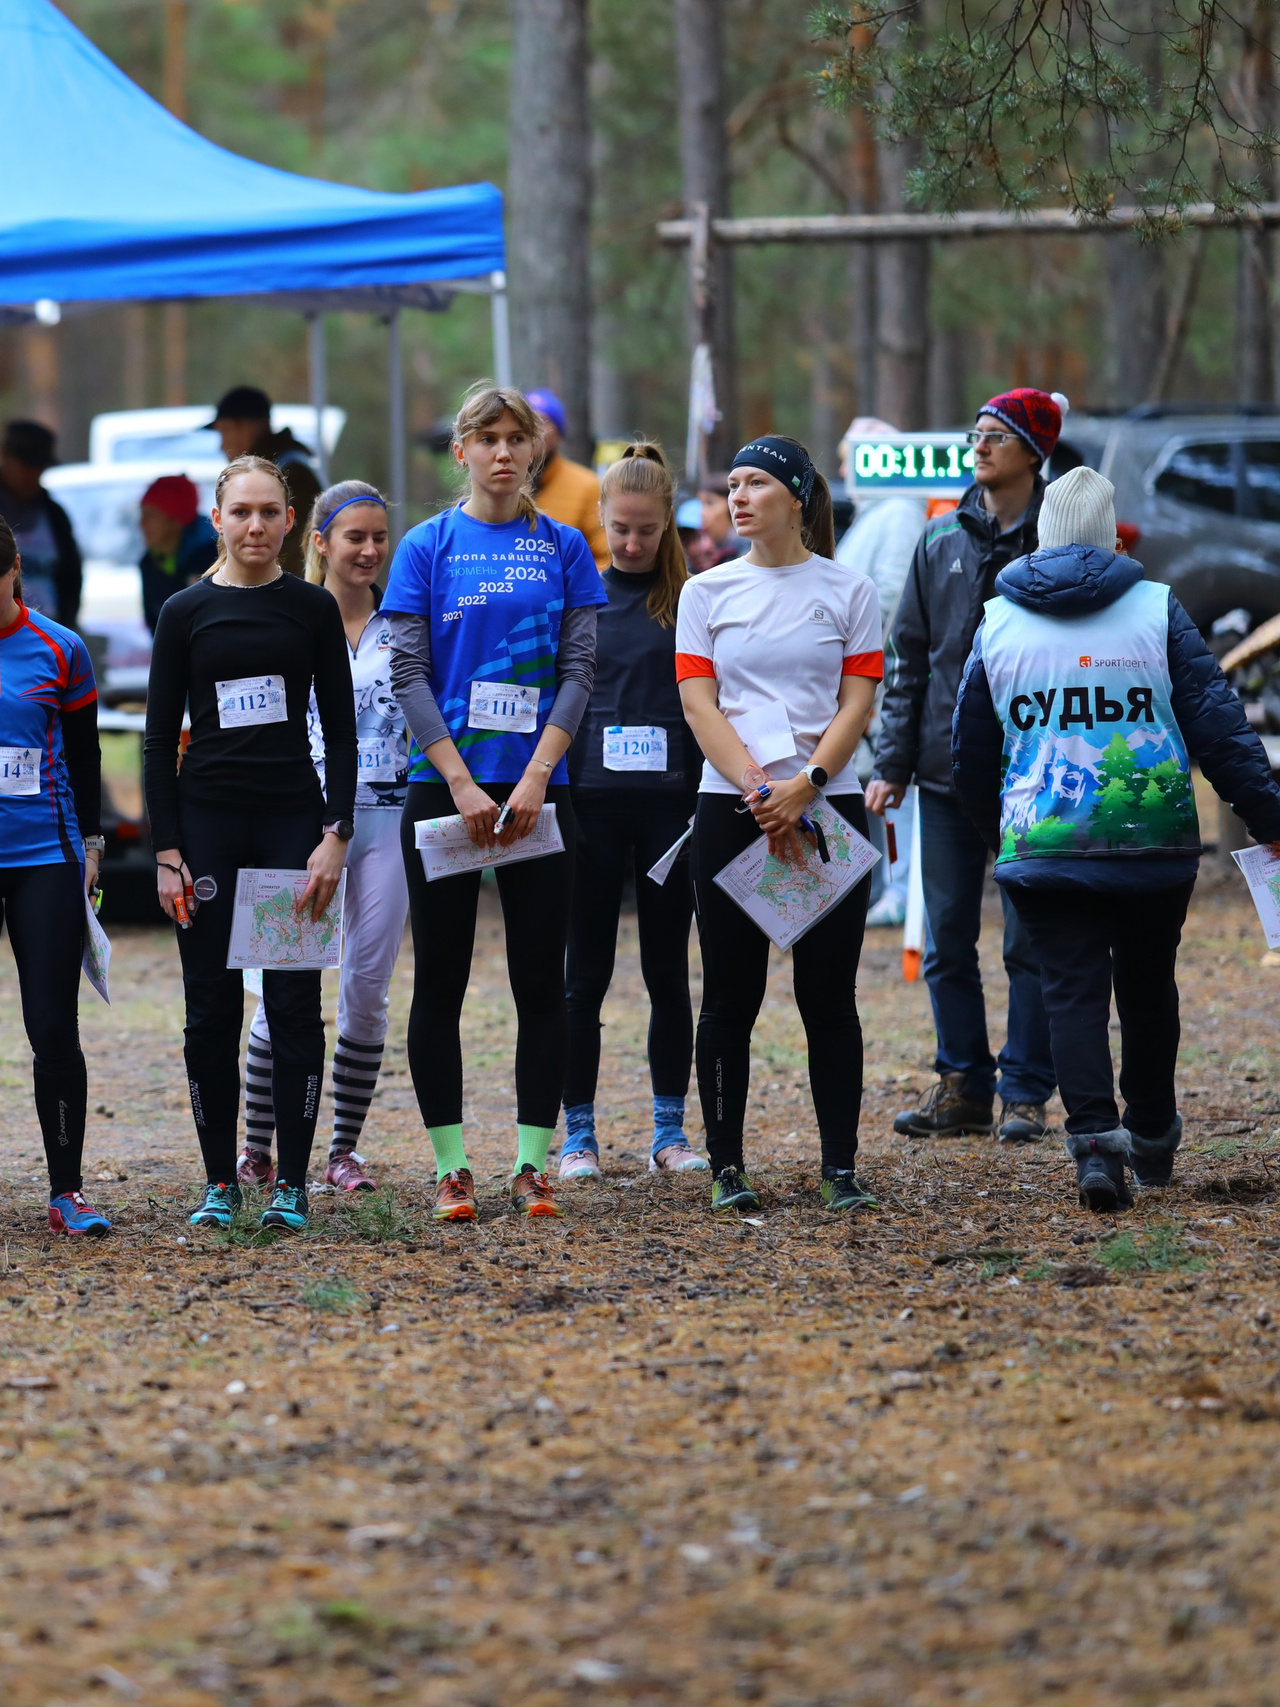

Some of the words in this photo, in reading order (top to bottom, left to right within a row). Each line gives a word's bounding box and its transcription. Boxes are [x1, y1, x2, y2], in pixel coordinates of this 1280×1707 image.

[514, 537, 556, 556] 2025
[447, 553, 487, 563] ТРОПА
[491, 552, 547, 564] ЗАЙЦЕВА
[449, 566, 498, 578] ТЮМЕНЬ
[504, 566, 548, 583] 2024
[478, 581, 514, 593] 2023
[457, 595, 487, 607] 2022
[442, 610, 463, 622] 2021
[239, 693, 267, 711] 112
[492, 700, 516, 716] 111
[1009, 686, 1155, 731] СУДЬЯ
[622, 741, 650, 755] 120
[358, 753, 380, 768] 121
